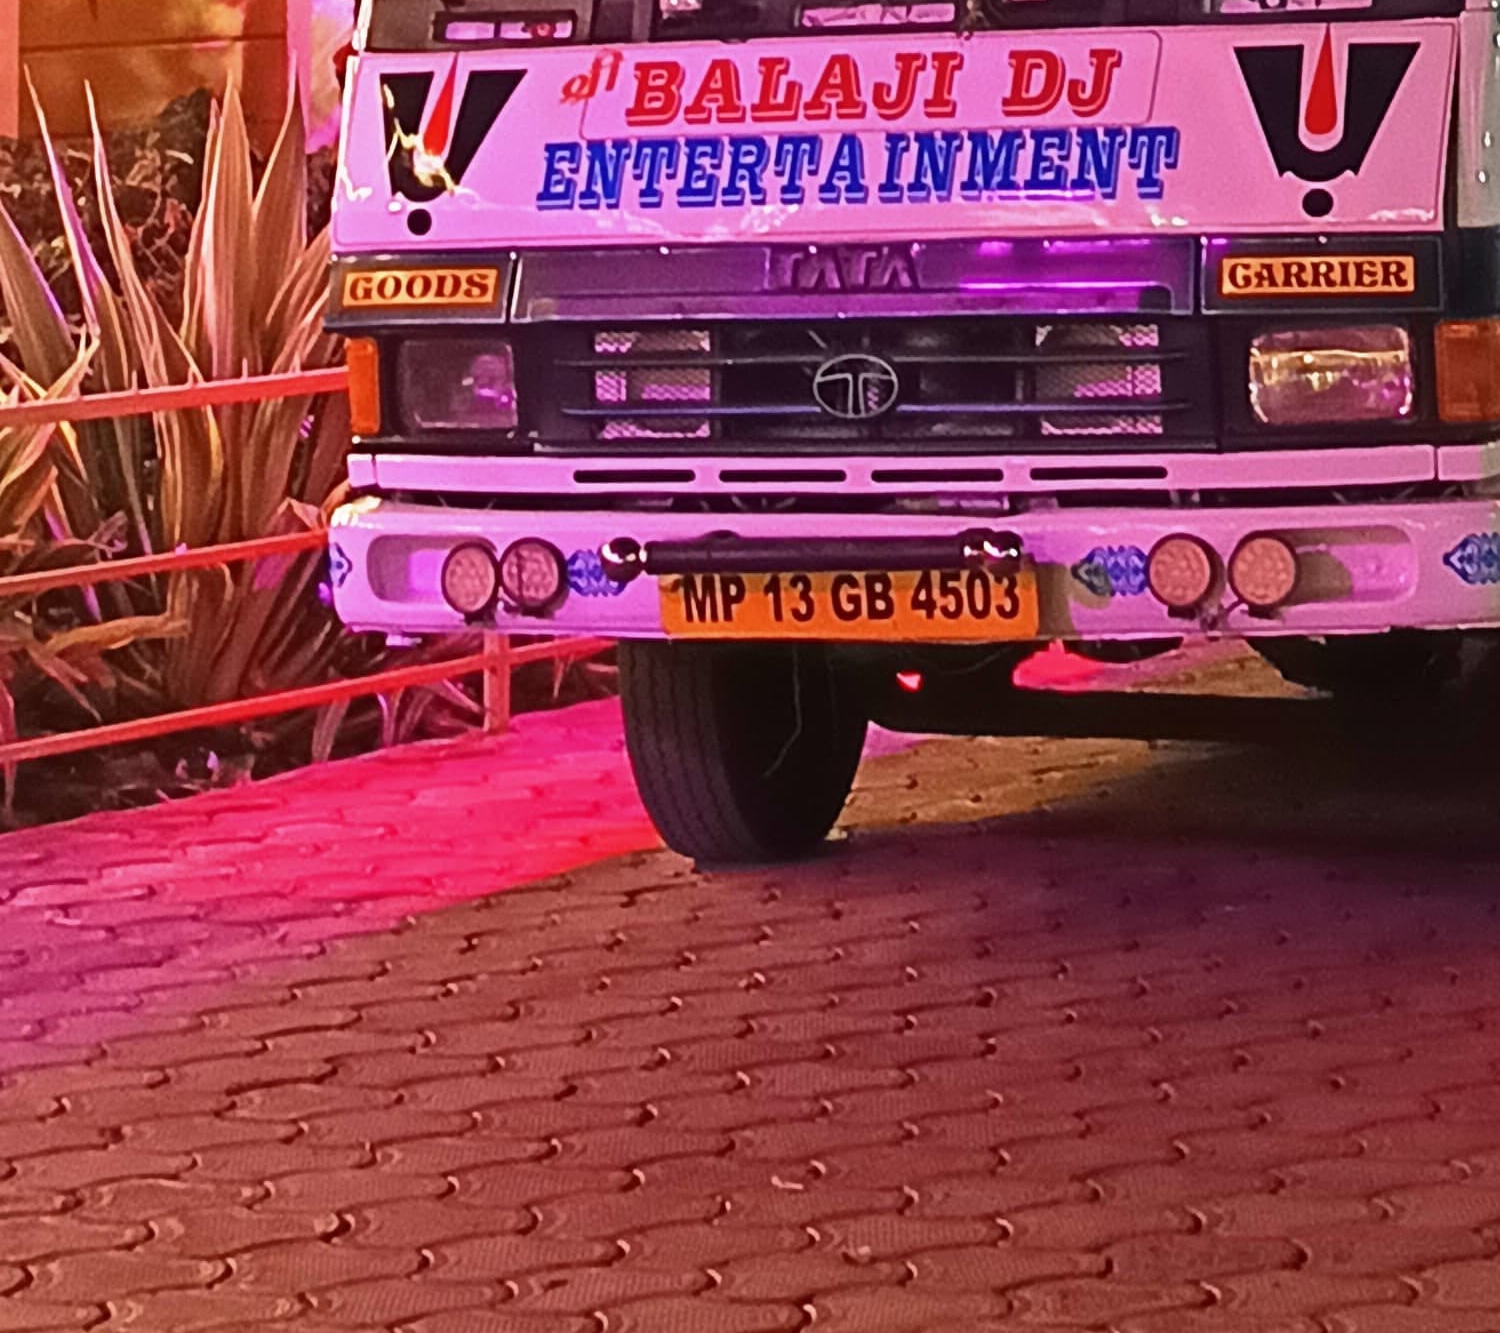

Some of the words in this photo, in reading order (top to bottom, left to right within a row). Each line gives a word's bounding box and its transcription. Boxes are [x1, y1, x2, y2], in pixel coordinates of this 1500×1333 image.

[625, 52, 964, 127] BALAJI
[1002, 48, 1122, 117] DJ
[536, 126, 1180, 210] ENTERTAINMENT
[349, 273, 490, 301] GOODS
[766, 245, 922, 290] TATA
[682, 573, 746, 623] MP
[763, 573, 815, 622] 13
[830, 571, 895, 621] GB
[910, 569, 1020, 620] 4503
